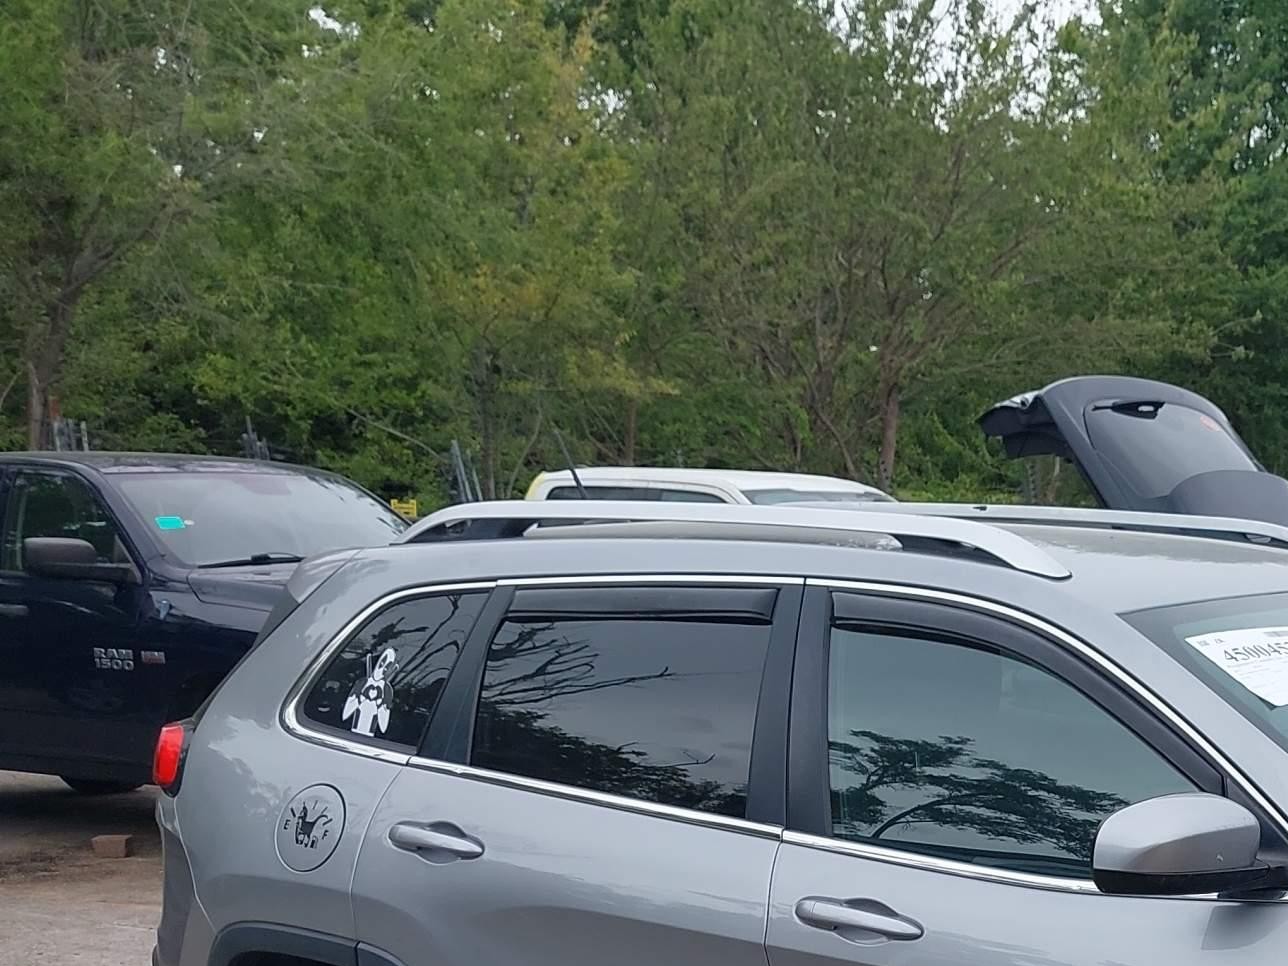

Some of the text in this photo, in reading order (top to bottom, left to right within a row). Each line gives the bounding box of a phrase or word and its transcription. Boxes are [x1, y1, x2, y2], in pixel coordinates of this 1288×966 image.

[93, 647, 134, 660] RAM
[94, 658, 135, 671] 1500
[283, 818, 292, 831] E
[321, 829, 330, 841] F
